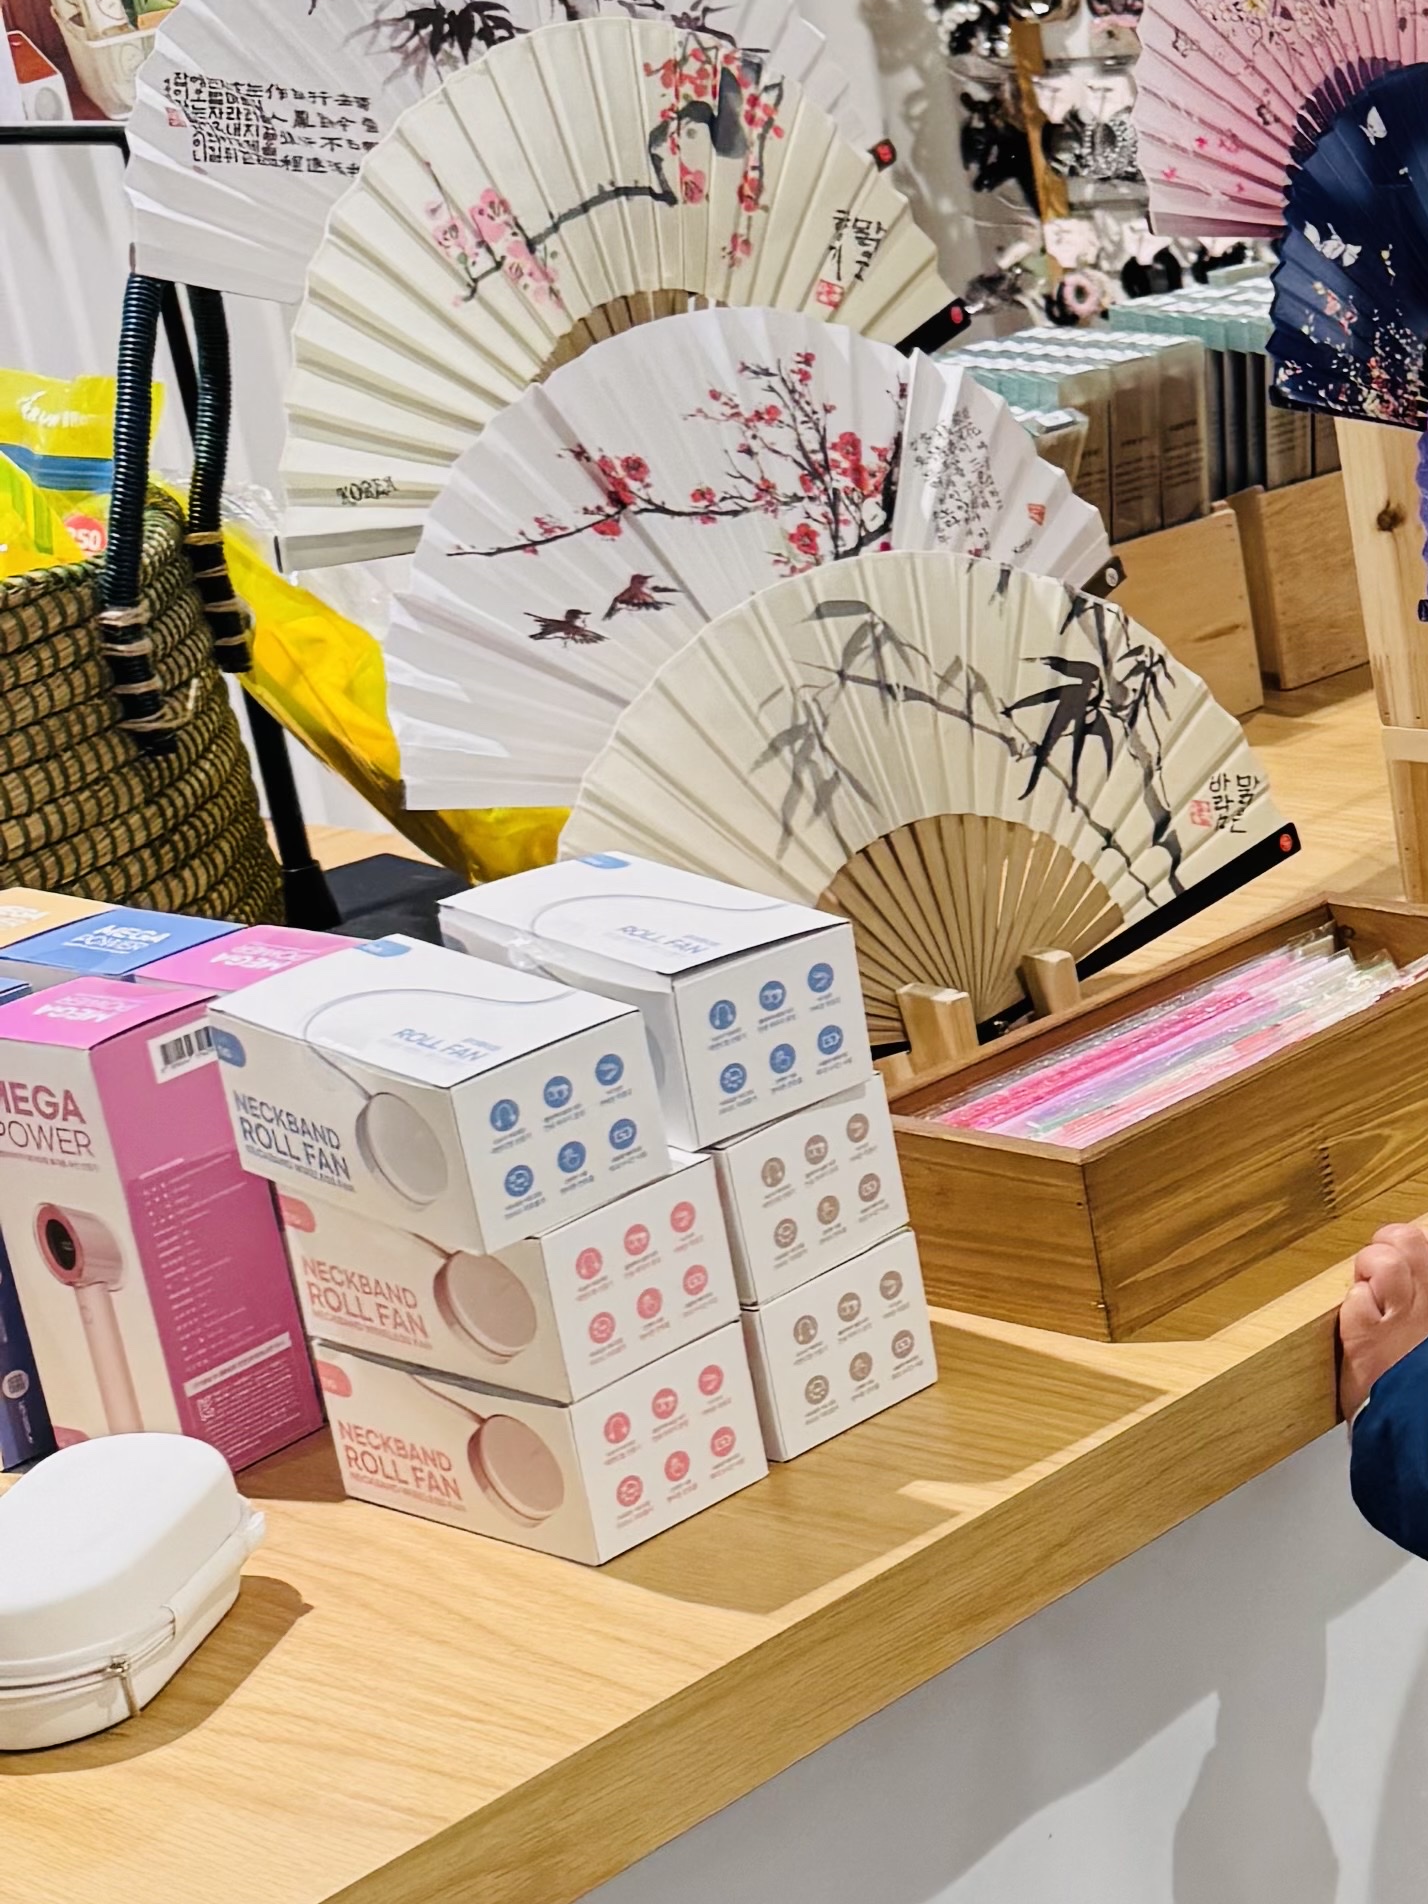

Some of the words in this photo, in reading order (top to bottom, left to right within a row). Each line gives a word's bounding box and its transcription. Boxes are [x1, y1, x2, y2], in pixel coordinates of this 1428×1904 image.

[96, 924, 171, 944] MEGA
[394, 1028, 445, 1049] ROLL
[442, 1040, 490, 1063] FAN
[232, 1089, 341, 1152] NECKBAND
[239, 1116, 301, 1163] ROLL
[302, 1144, 351, 1183] FAN
[302, 1255, 418, 1310] NECKBAND
[306, 1280, 373, 1324] ROLL
[375, 1303, 429, 1339] FAN
[338, 1420, 453, 1473] NECKBAND
[344, 1444, 409, 1485] ROLL
[410, 1466, 464, 1501] FAN
